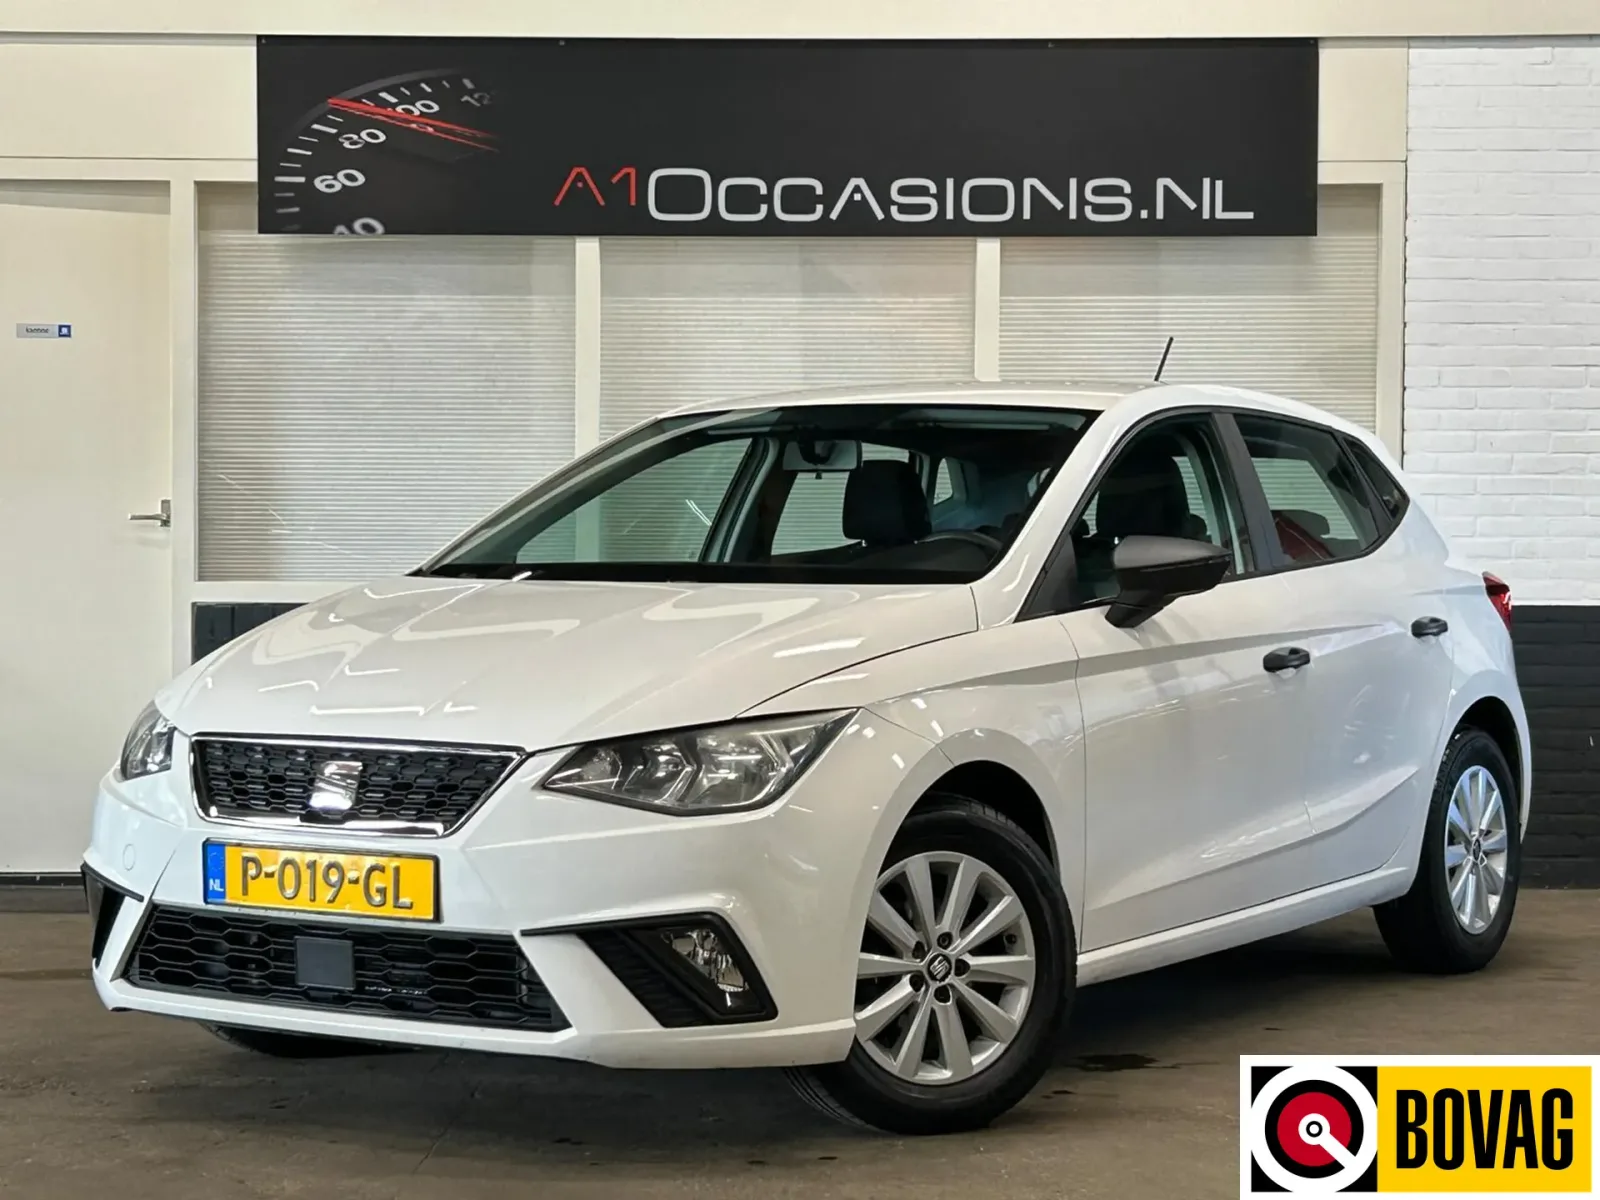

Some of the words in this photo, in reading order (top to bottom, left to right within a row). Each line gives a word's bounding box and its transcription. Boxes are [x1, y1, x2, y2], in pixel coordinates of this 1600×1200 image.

[387, 100, 440, 116] 00
[338, 128, 387, 149] 80
[313, 168, 366, 193] 60
[209, 878, 225, 892] NL
[241, 854, 414, 910] P-019-GL
